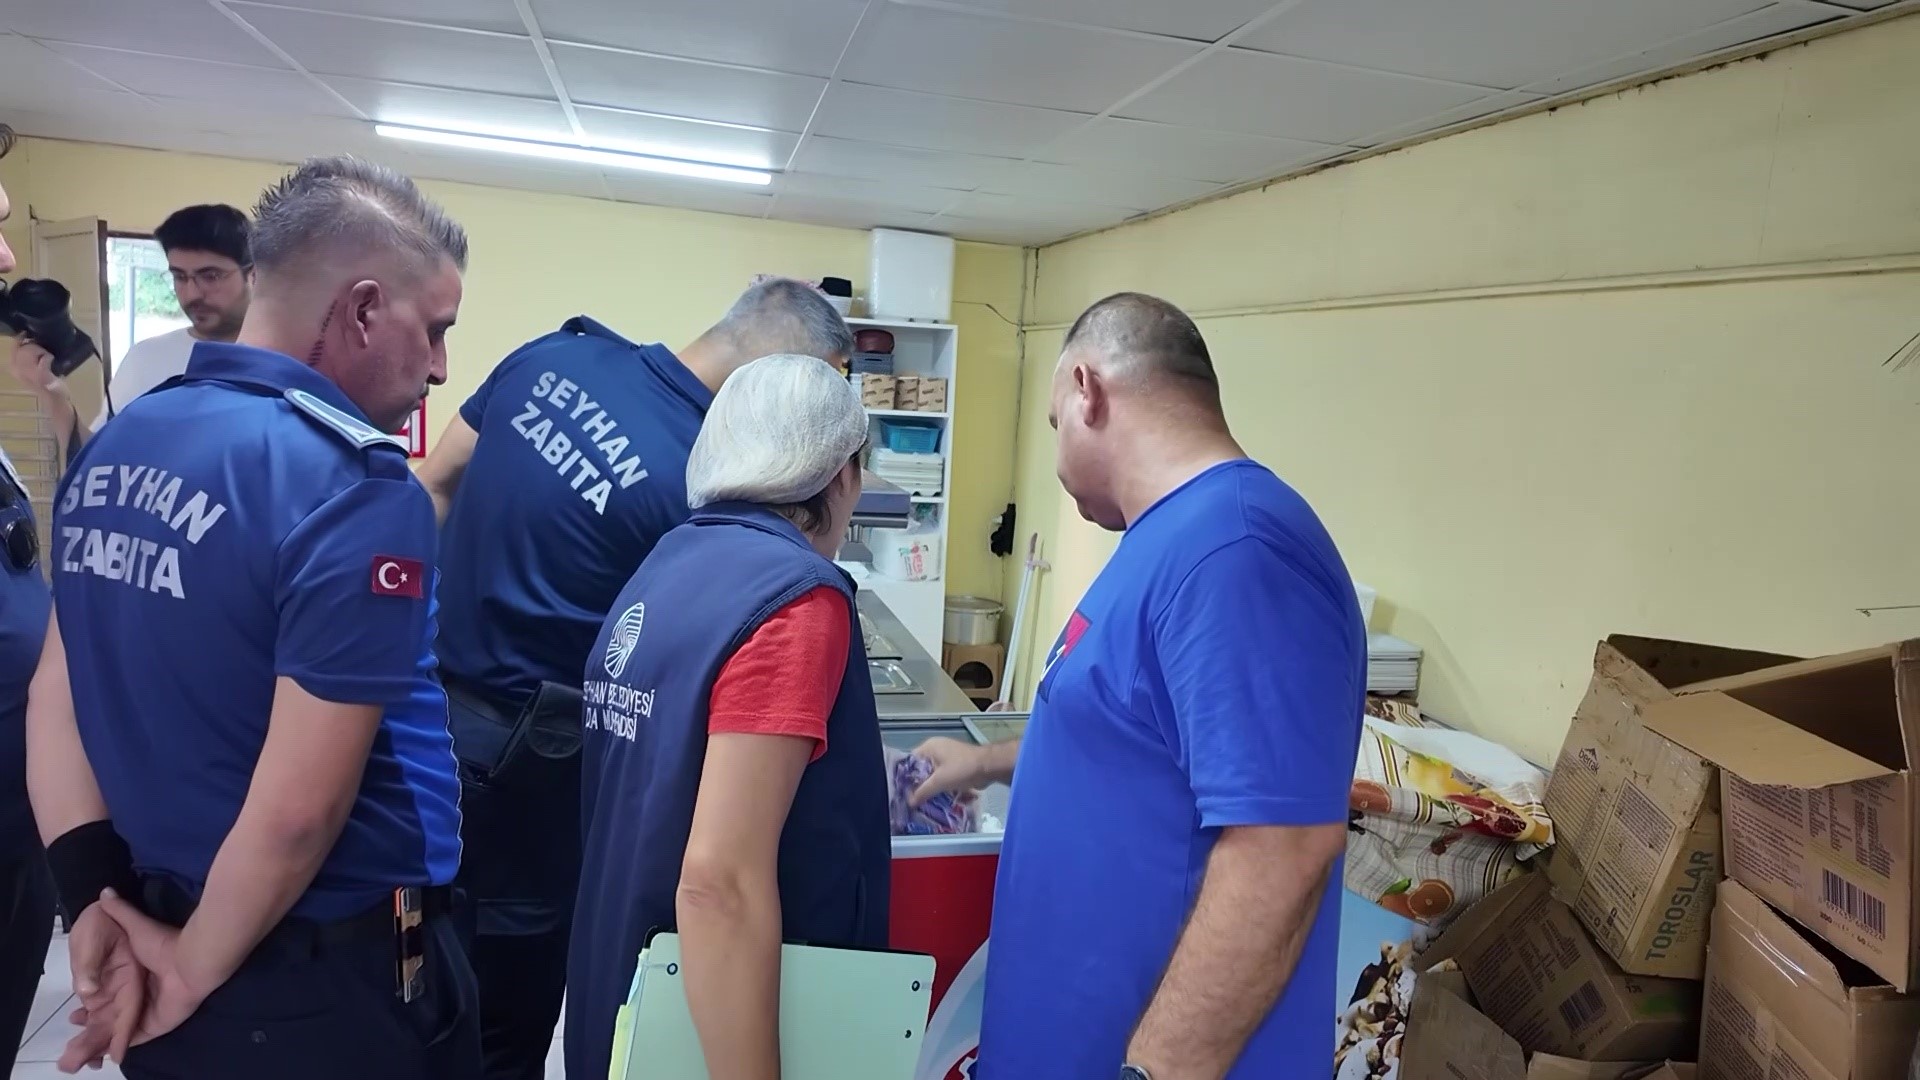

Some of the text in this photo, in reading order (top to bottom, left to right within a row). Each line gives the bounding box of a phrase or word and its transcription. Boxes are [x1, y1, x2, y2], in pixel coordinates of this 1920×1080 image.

[510, 401, 613, 515] ZABITA
[532, 371, 648, 489] SEYHAN
[61, 464, 227, 544] SEYHAN
[61, 526, 185, 599] ZABITA
[1579, 748, 1600, 775] berrak
[1645, 850, 1714, 960] TOROSLAR
